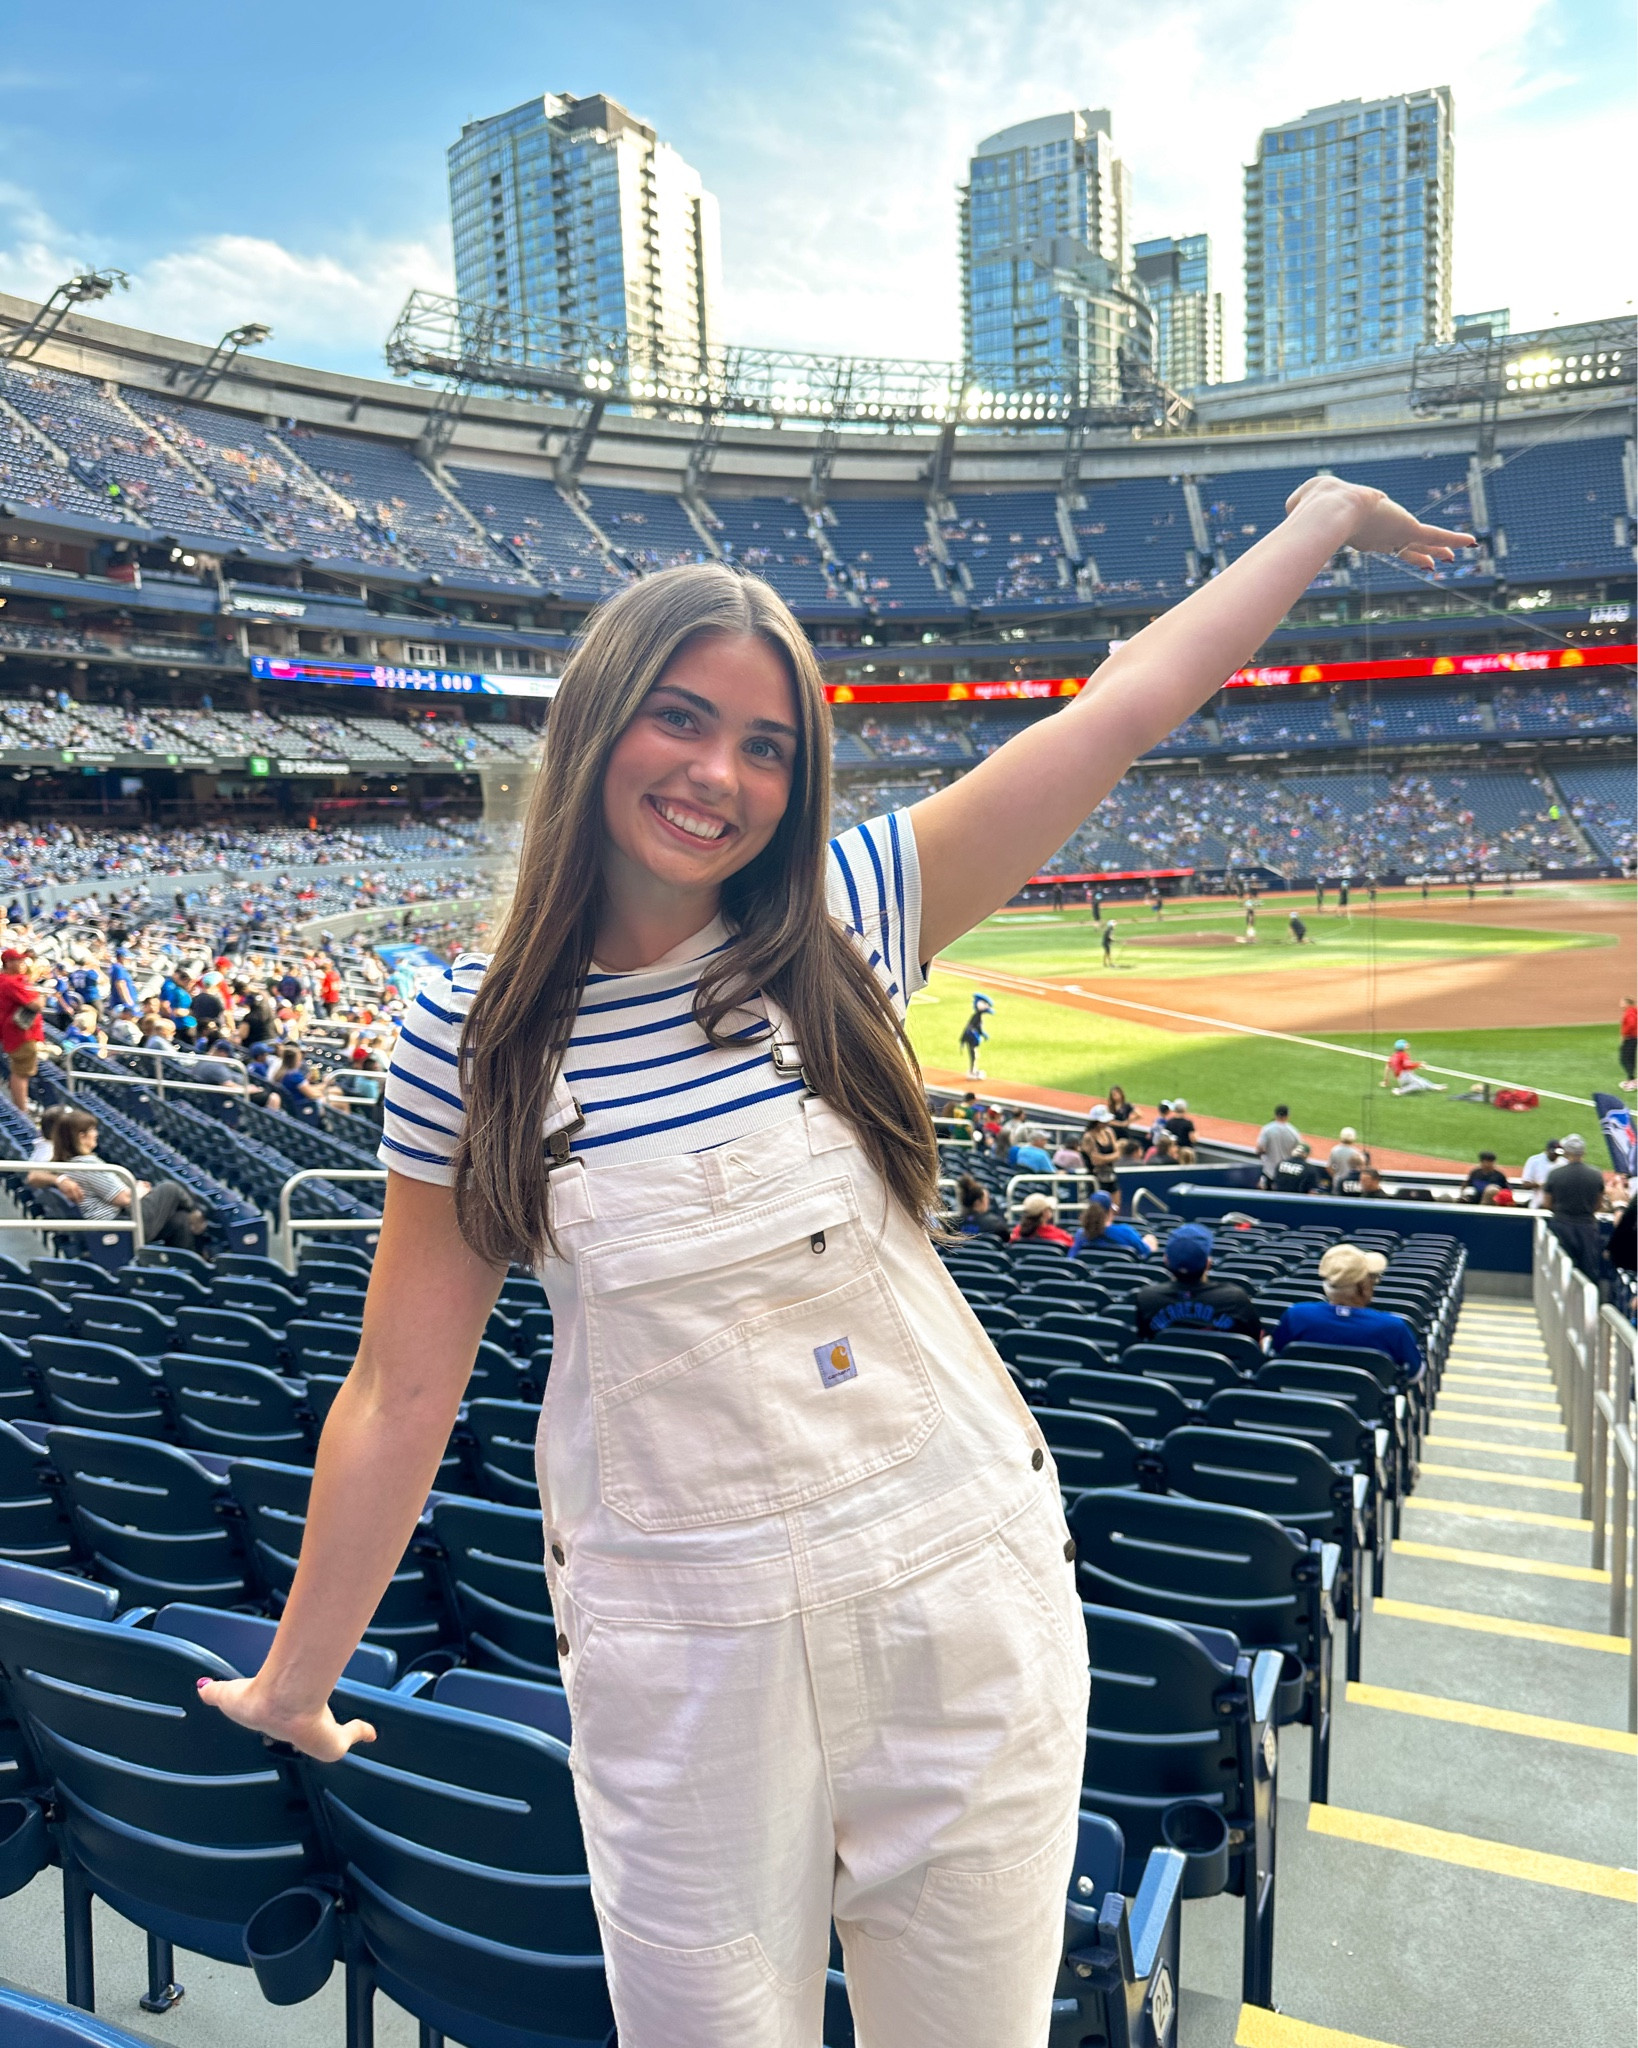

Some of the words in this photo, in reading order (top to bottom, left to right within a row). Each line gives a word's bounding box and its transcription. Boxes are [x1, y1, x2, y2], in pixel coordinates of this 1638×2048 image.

[234, 597, 307, 616] SPORTSNET
[1589, 604, 1631, 624] KPMG
[277, 760, 294, 774] TD
[294, 760, 350, 775] Clubhouse
[1155, 1978, 1170, 2030] 24
